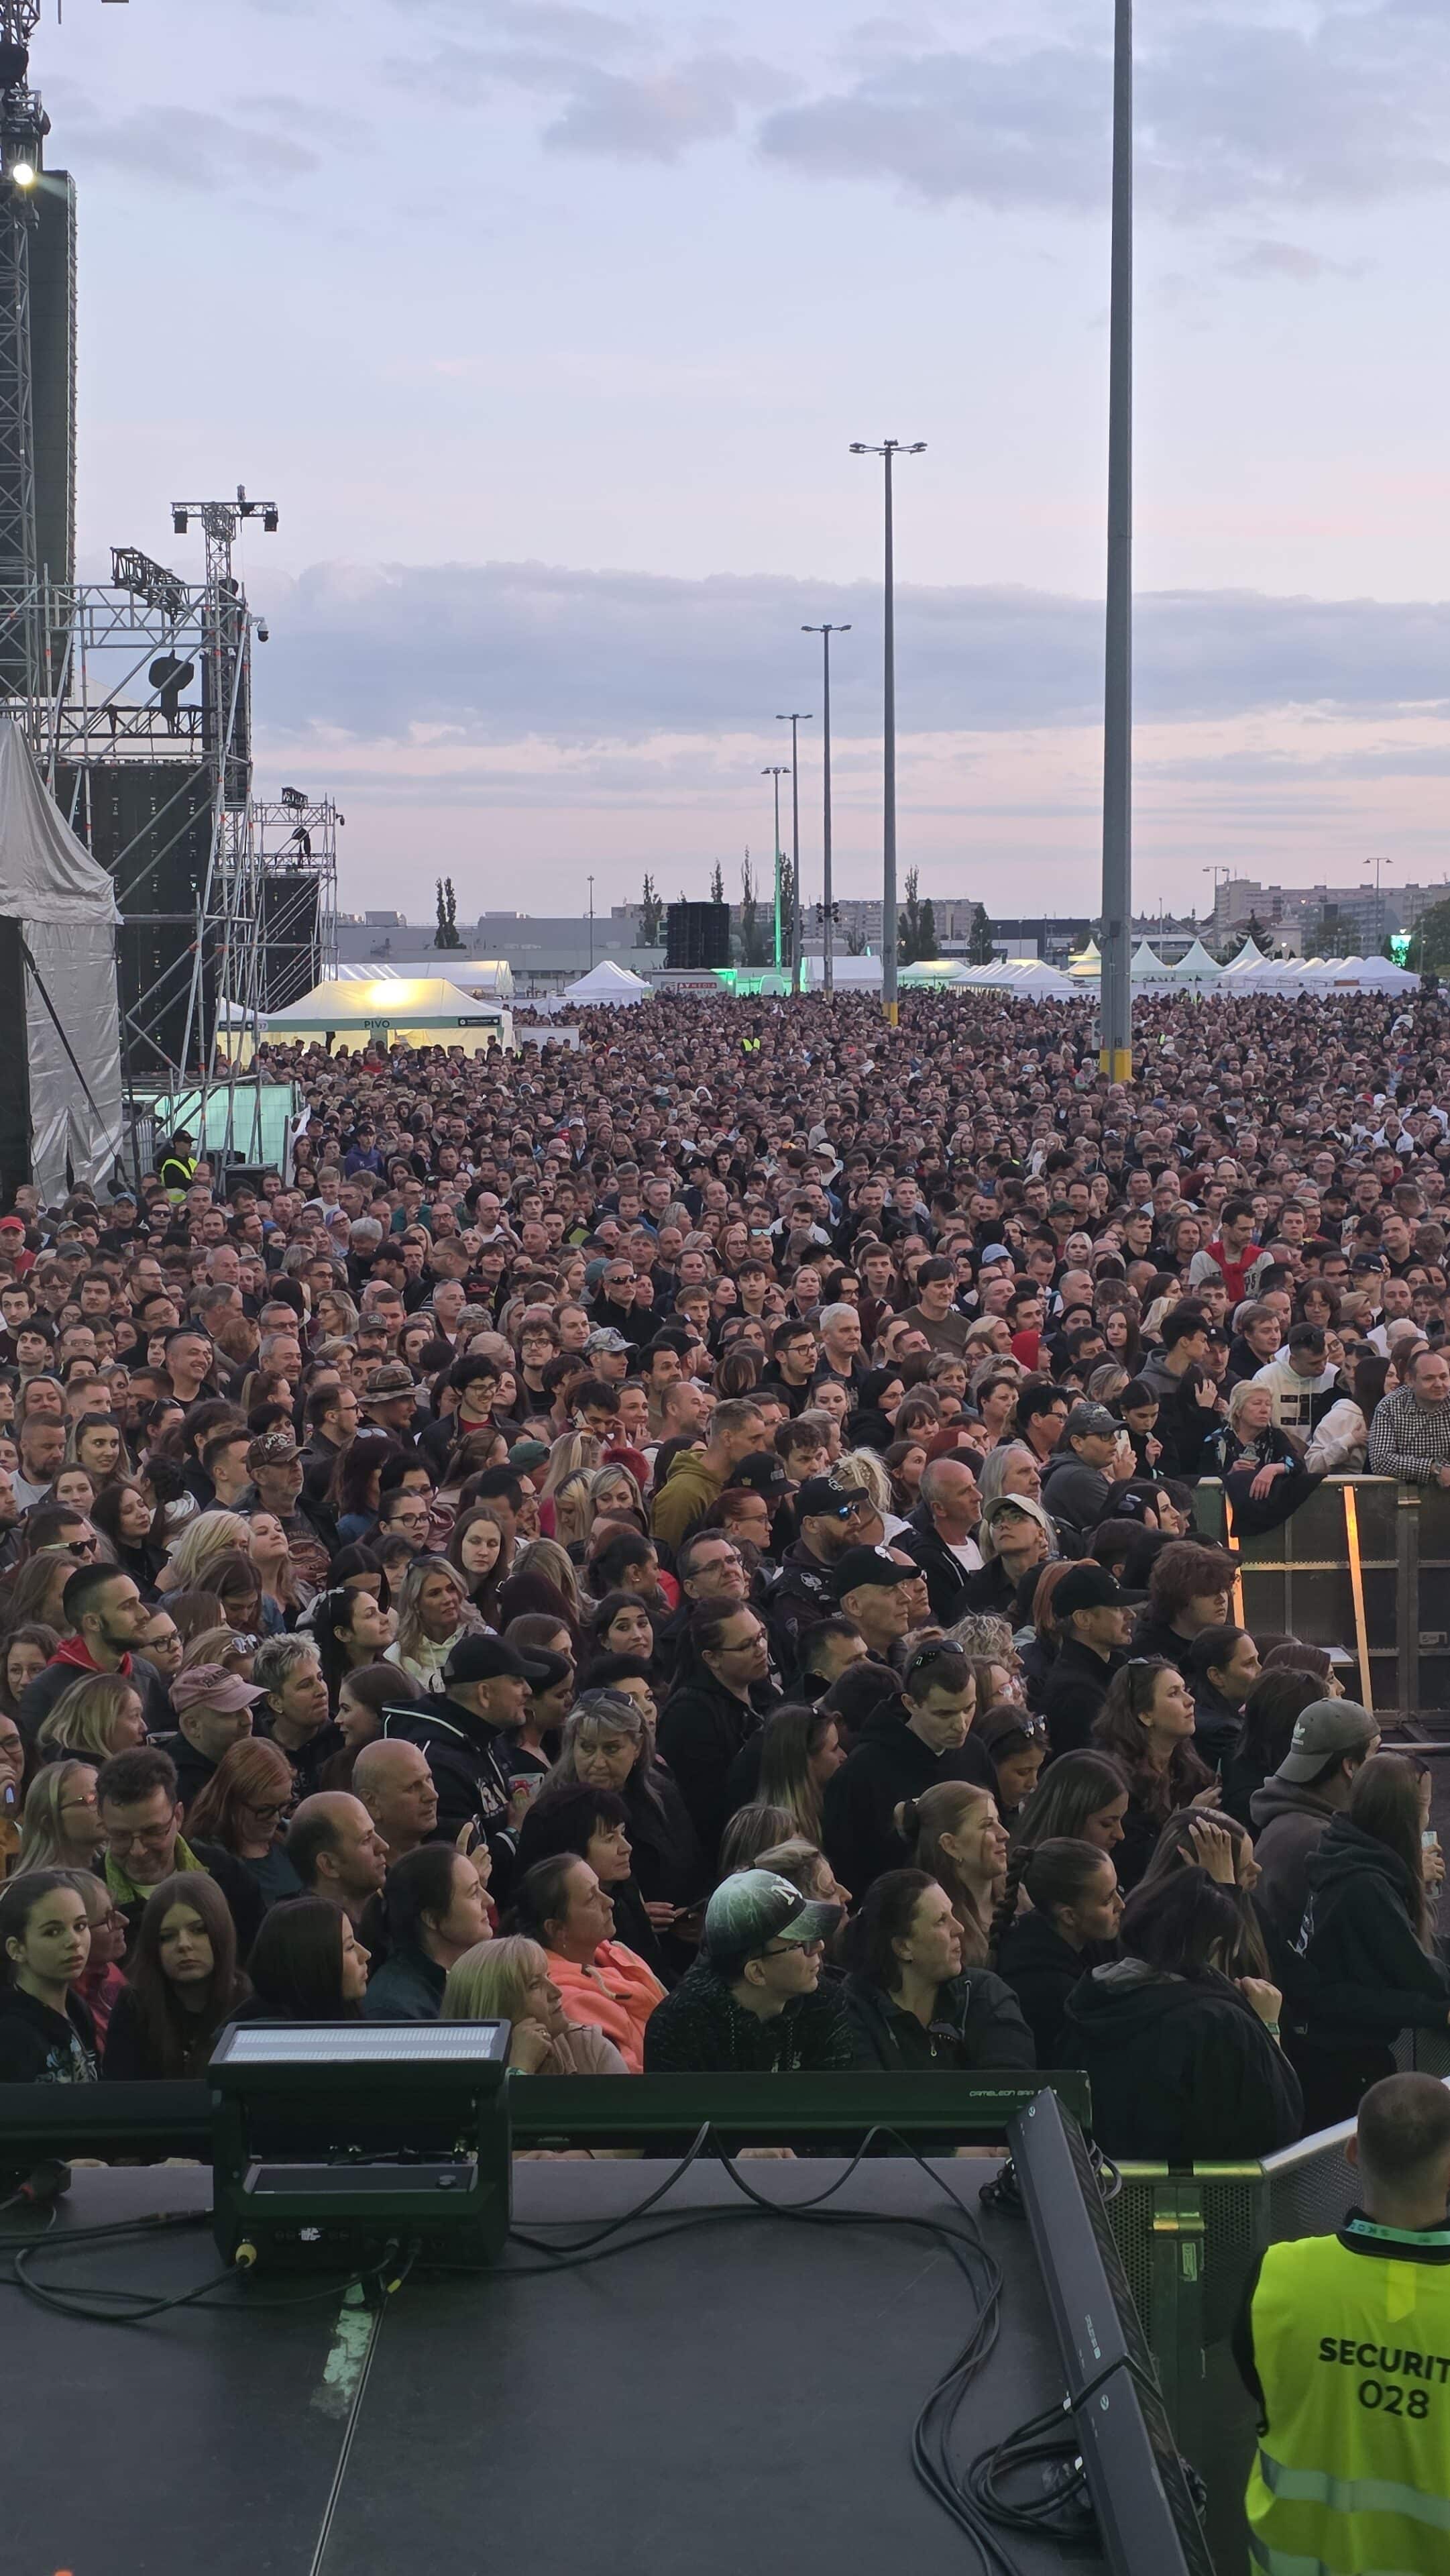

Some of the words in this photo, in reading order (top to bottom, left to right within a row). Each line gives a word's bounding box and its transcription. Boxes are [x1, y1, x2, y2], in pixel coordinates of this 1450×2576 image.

[364, 1020, 390, 1028] PIVO
[1319, 2337, 1450, 2383] SECURIT
[1359, 2379, 1429, 2419] 028
